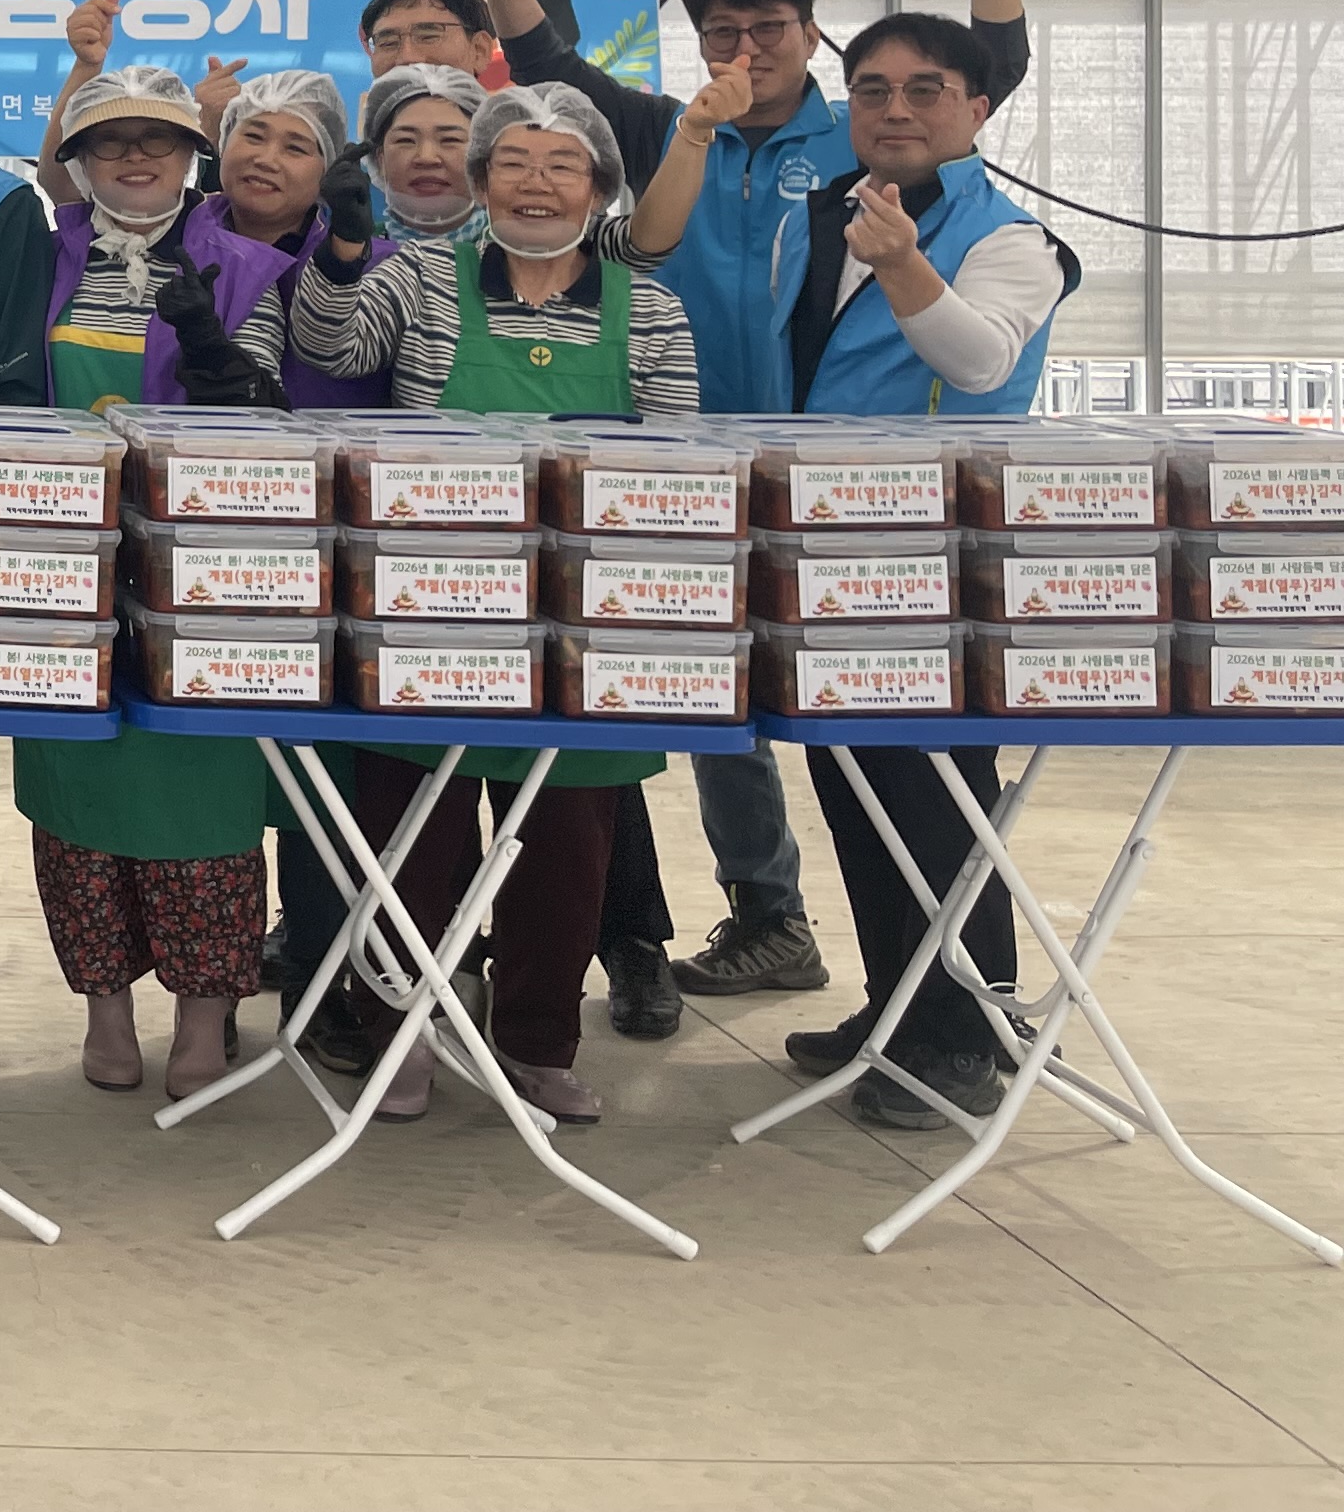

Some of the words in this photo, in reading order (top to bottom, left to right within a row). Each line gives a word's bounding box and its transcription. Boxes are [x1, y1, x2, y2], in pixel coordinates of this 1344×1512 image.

[79, 471, 100, 484] 담은
[179, 464, 216, 476] 2026년
[289, 467, 310, 479] 담은
[385, 469, 423, 481] 2026년
[805, 471, 843, 483] 2026년
[1015, 472, 1054, 484] 2026년
[1222, 469, 1261, 482] 2026년
[598, 477, 636, 490] 2026년
[184, 554, 221, 566] 2026년
[293, 555, 314, 567] 담은
